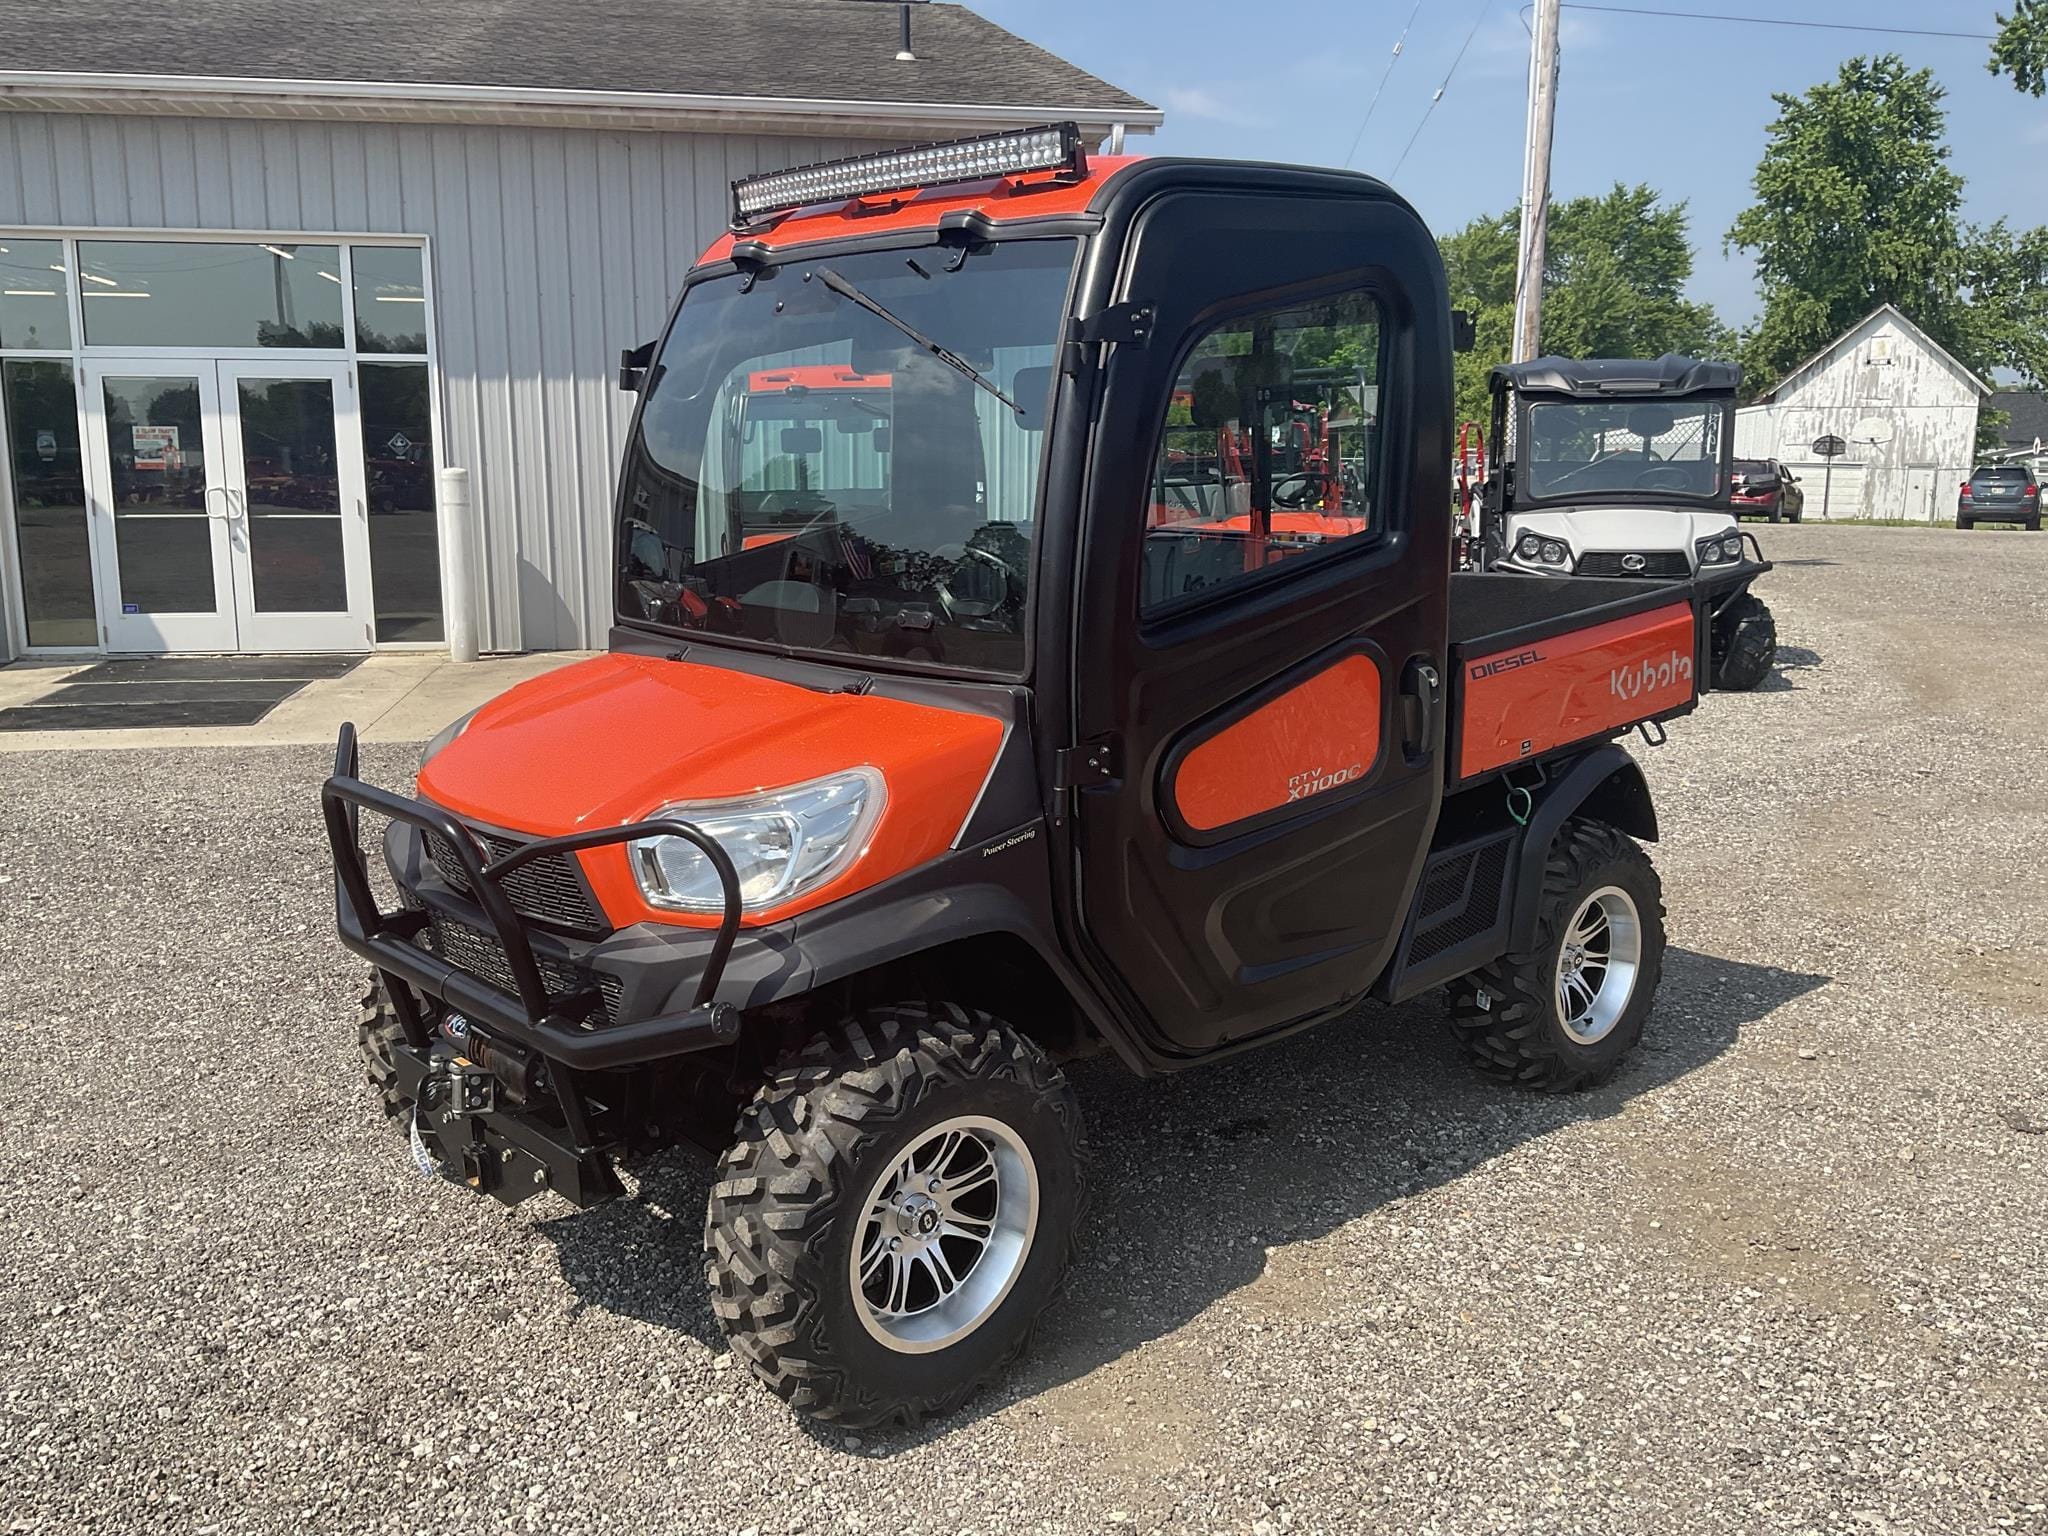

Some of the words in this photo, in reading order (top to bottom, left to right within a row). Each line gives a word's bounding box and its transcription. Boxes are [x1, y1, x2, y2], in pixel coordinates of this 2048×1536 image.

[1470, 650, 1547, 680] DIESEL
[1610, 650, 1692, 700] Kubota
[1286, 763, 1361, 803] X1100C
[1289, 767, 1322, 788] RTV
[983, 843, 1007, 858] Power
[1006, 829, 1036, 847] Steering
